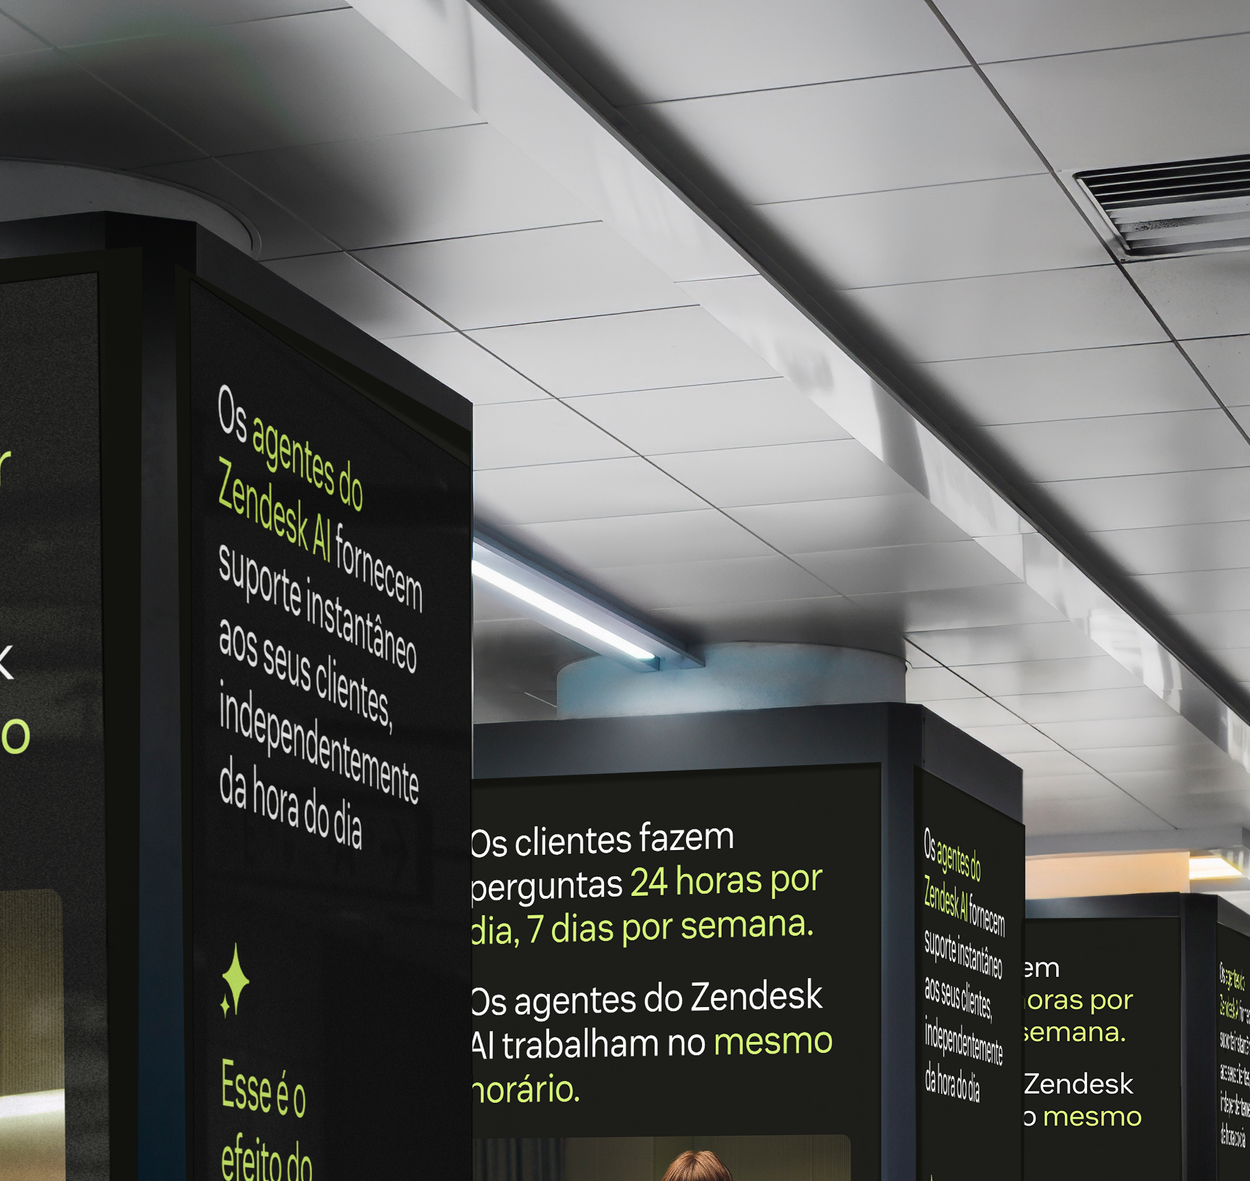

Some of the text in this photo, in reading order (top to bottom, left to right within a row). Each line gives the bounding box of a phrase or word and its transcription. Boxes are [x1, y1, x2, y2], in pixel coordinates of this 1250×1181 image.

[218, 384, 363, 512] Os agentes do
[218, 455, 423, 614] Zendesk AI fornecem
[218, 544, 417, 674] suporte instantâneo
[219, 618, 393, 736] aos seus clientes,
[219, 678, 420, 806] independentemente
[219, 754, 362, 851] da hora do dia
[471, 820, 734, 859] Os clientes fazem
[924, 827, 981, 882] Os agentes do
[471, 864, 824, 909] perguntas 24 horas por
[925, 874, 959, 918] Zendesk
[969, 893, 1005, 938] fornecem
[471, 912, 814, 949] dia, 7 dias por semana.
[925, 930, 1002, 980] suporte instantâneo
[514, 986, 637, 1023] agentes
[644, 981, 683, 1013] do
[690, 977, 824, 1012] Zendesk
[925, 977, 992, 1024] aos seus clientes,
[1024, 992, 1134, 1015] oras por
[471, 1026, 833, 1060] AI trabalham no mesmo
[925, 1015, 1003, 1066] independentemente
[222, 1058, 306, 1119] Esse é o
[925, 1060, 980, 1103] da hora do dia
[1023, 1071, 1134, 1095] Zendesk
[1044, 1110, 1142, 1127] mesmo
